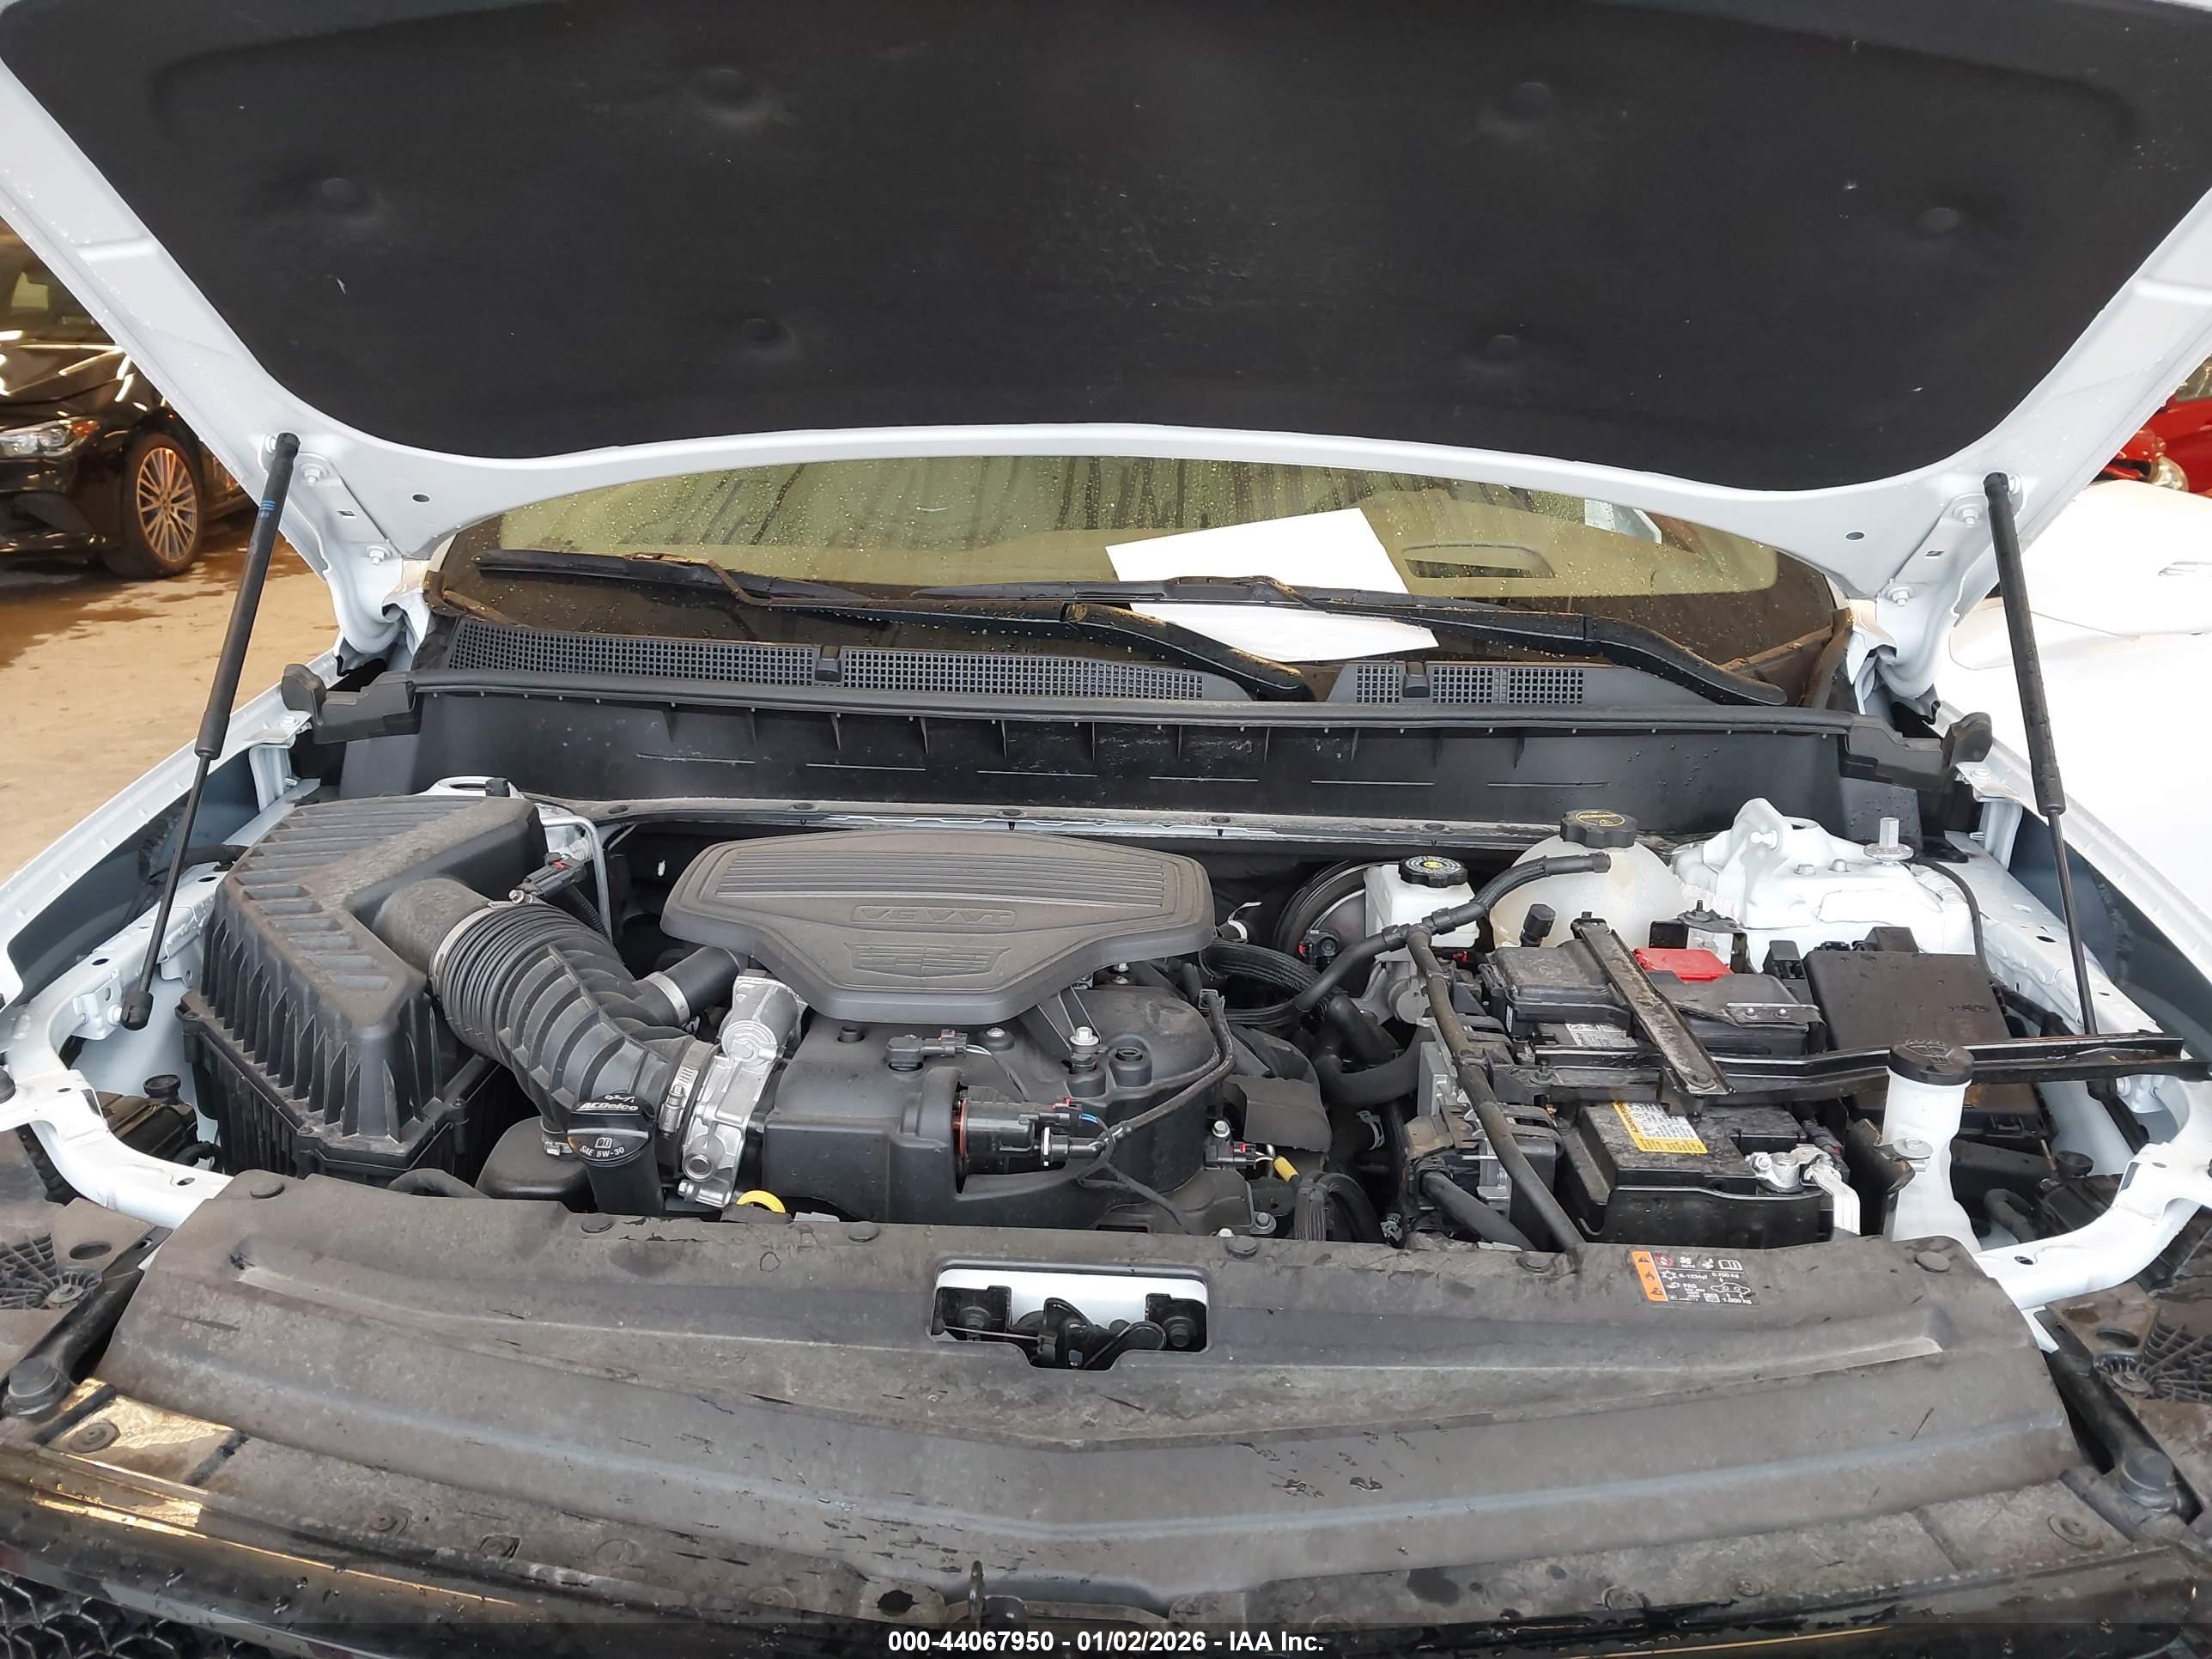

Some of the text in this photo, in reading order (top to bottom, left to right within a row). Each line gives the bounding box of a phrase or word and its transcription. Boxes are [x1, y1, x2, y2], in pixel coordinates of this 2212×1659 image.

[926, 910, 1012, 925] VVT
[579, 1103, 640, 1111] ACDelco
[580, 1146, 625, 1158] SAE 5W-30
